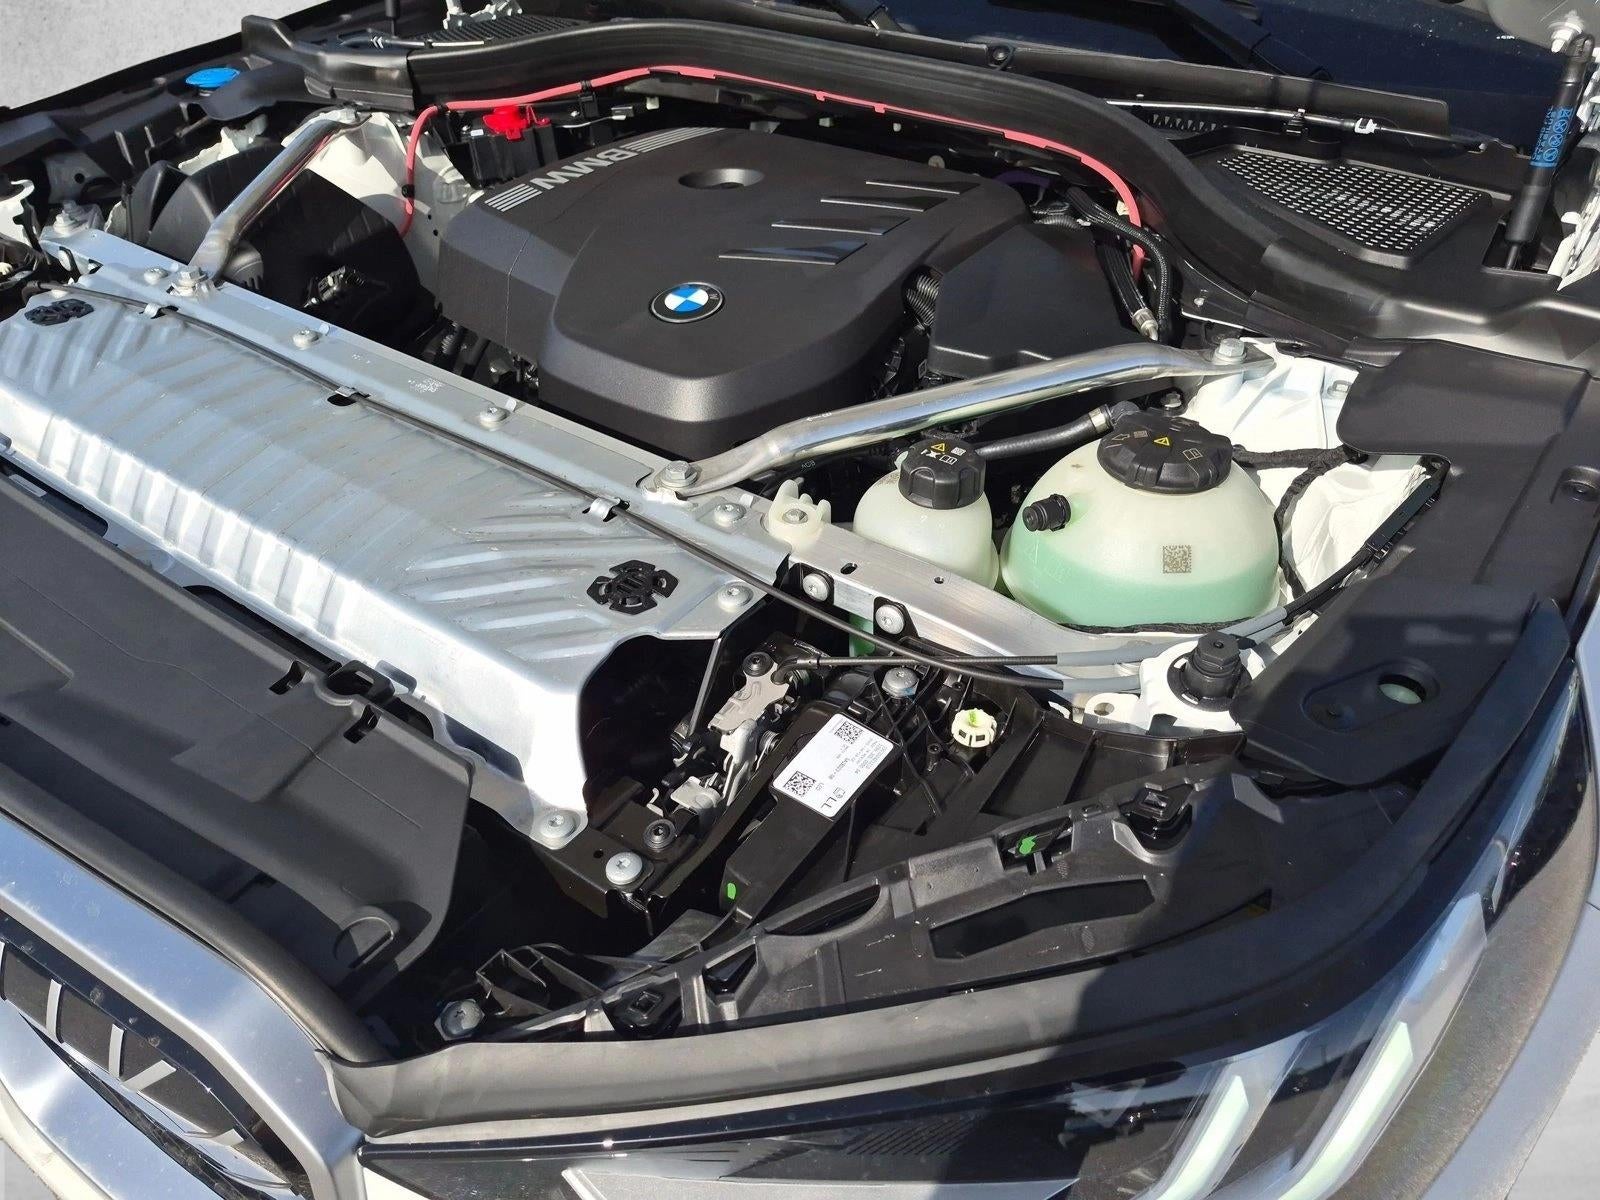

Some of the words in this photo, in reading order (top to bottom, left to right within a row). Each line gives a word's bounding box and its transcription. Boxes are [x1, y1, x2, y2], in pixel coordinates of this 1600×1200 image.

[1535, 111, 1556, 160] STABILUS
[530, 148, 639, 190] BMW
[821, 797, 837, 808] LL
